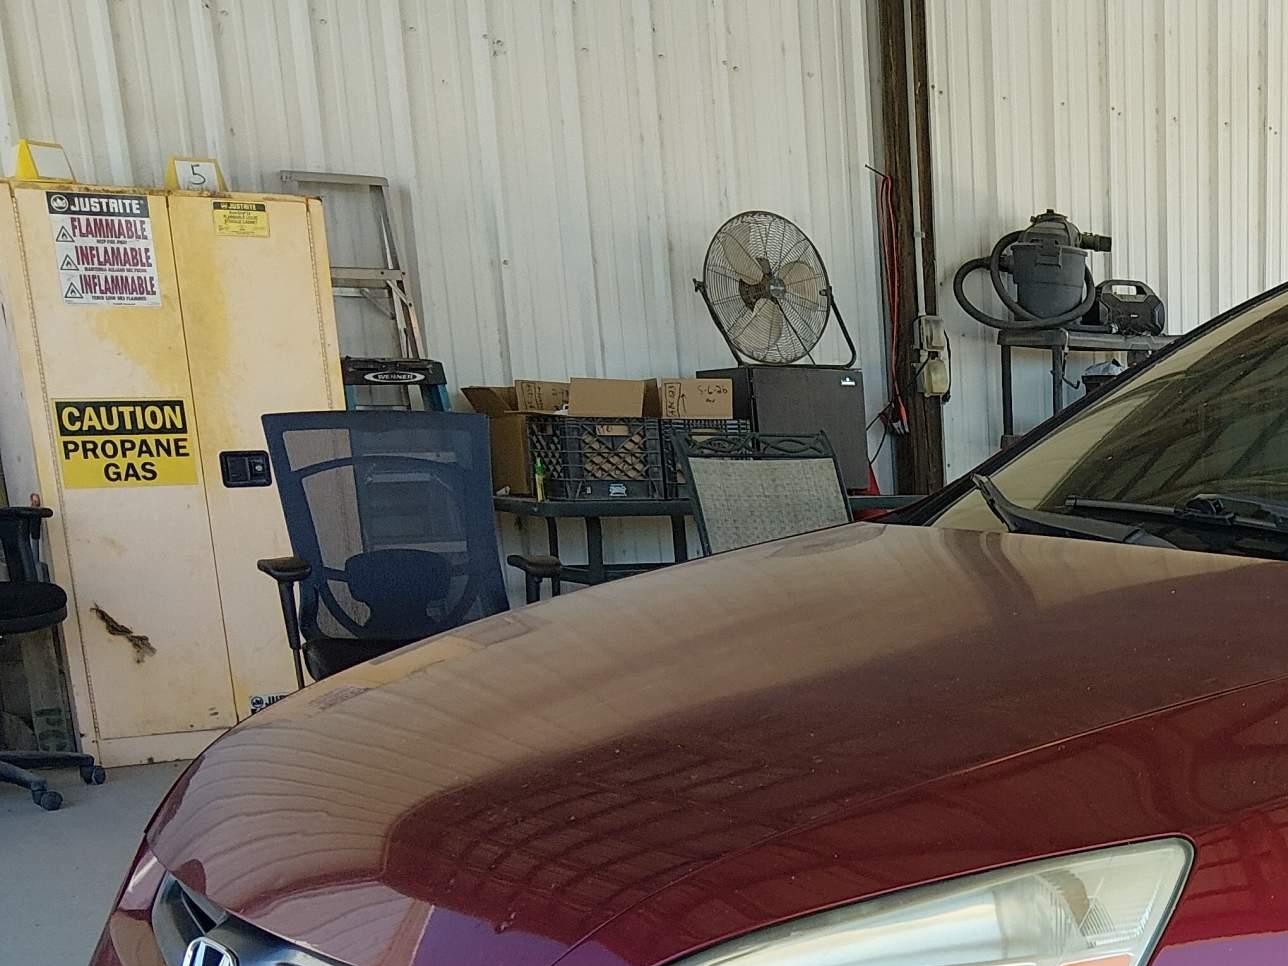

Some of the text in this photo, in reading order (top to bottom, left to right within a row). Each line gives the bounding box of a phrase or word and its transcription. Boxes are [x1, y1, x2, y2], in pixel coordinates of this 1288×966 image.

[190, 164, 206, 185] 5
[69, 196, 141, 214] JUSTRITE
[70, 216, 148, 241] FLAMMABLE
[74, 245, 153, 268] INFLAMABLE
[79, 274, 157, 296] INFLAMMABLE
[61, 405, 184, 432] CAUTION
[62, 438, 190, 460] PROPANE
[103, 461, 158, 482] GAS
